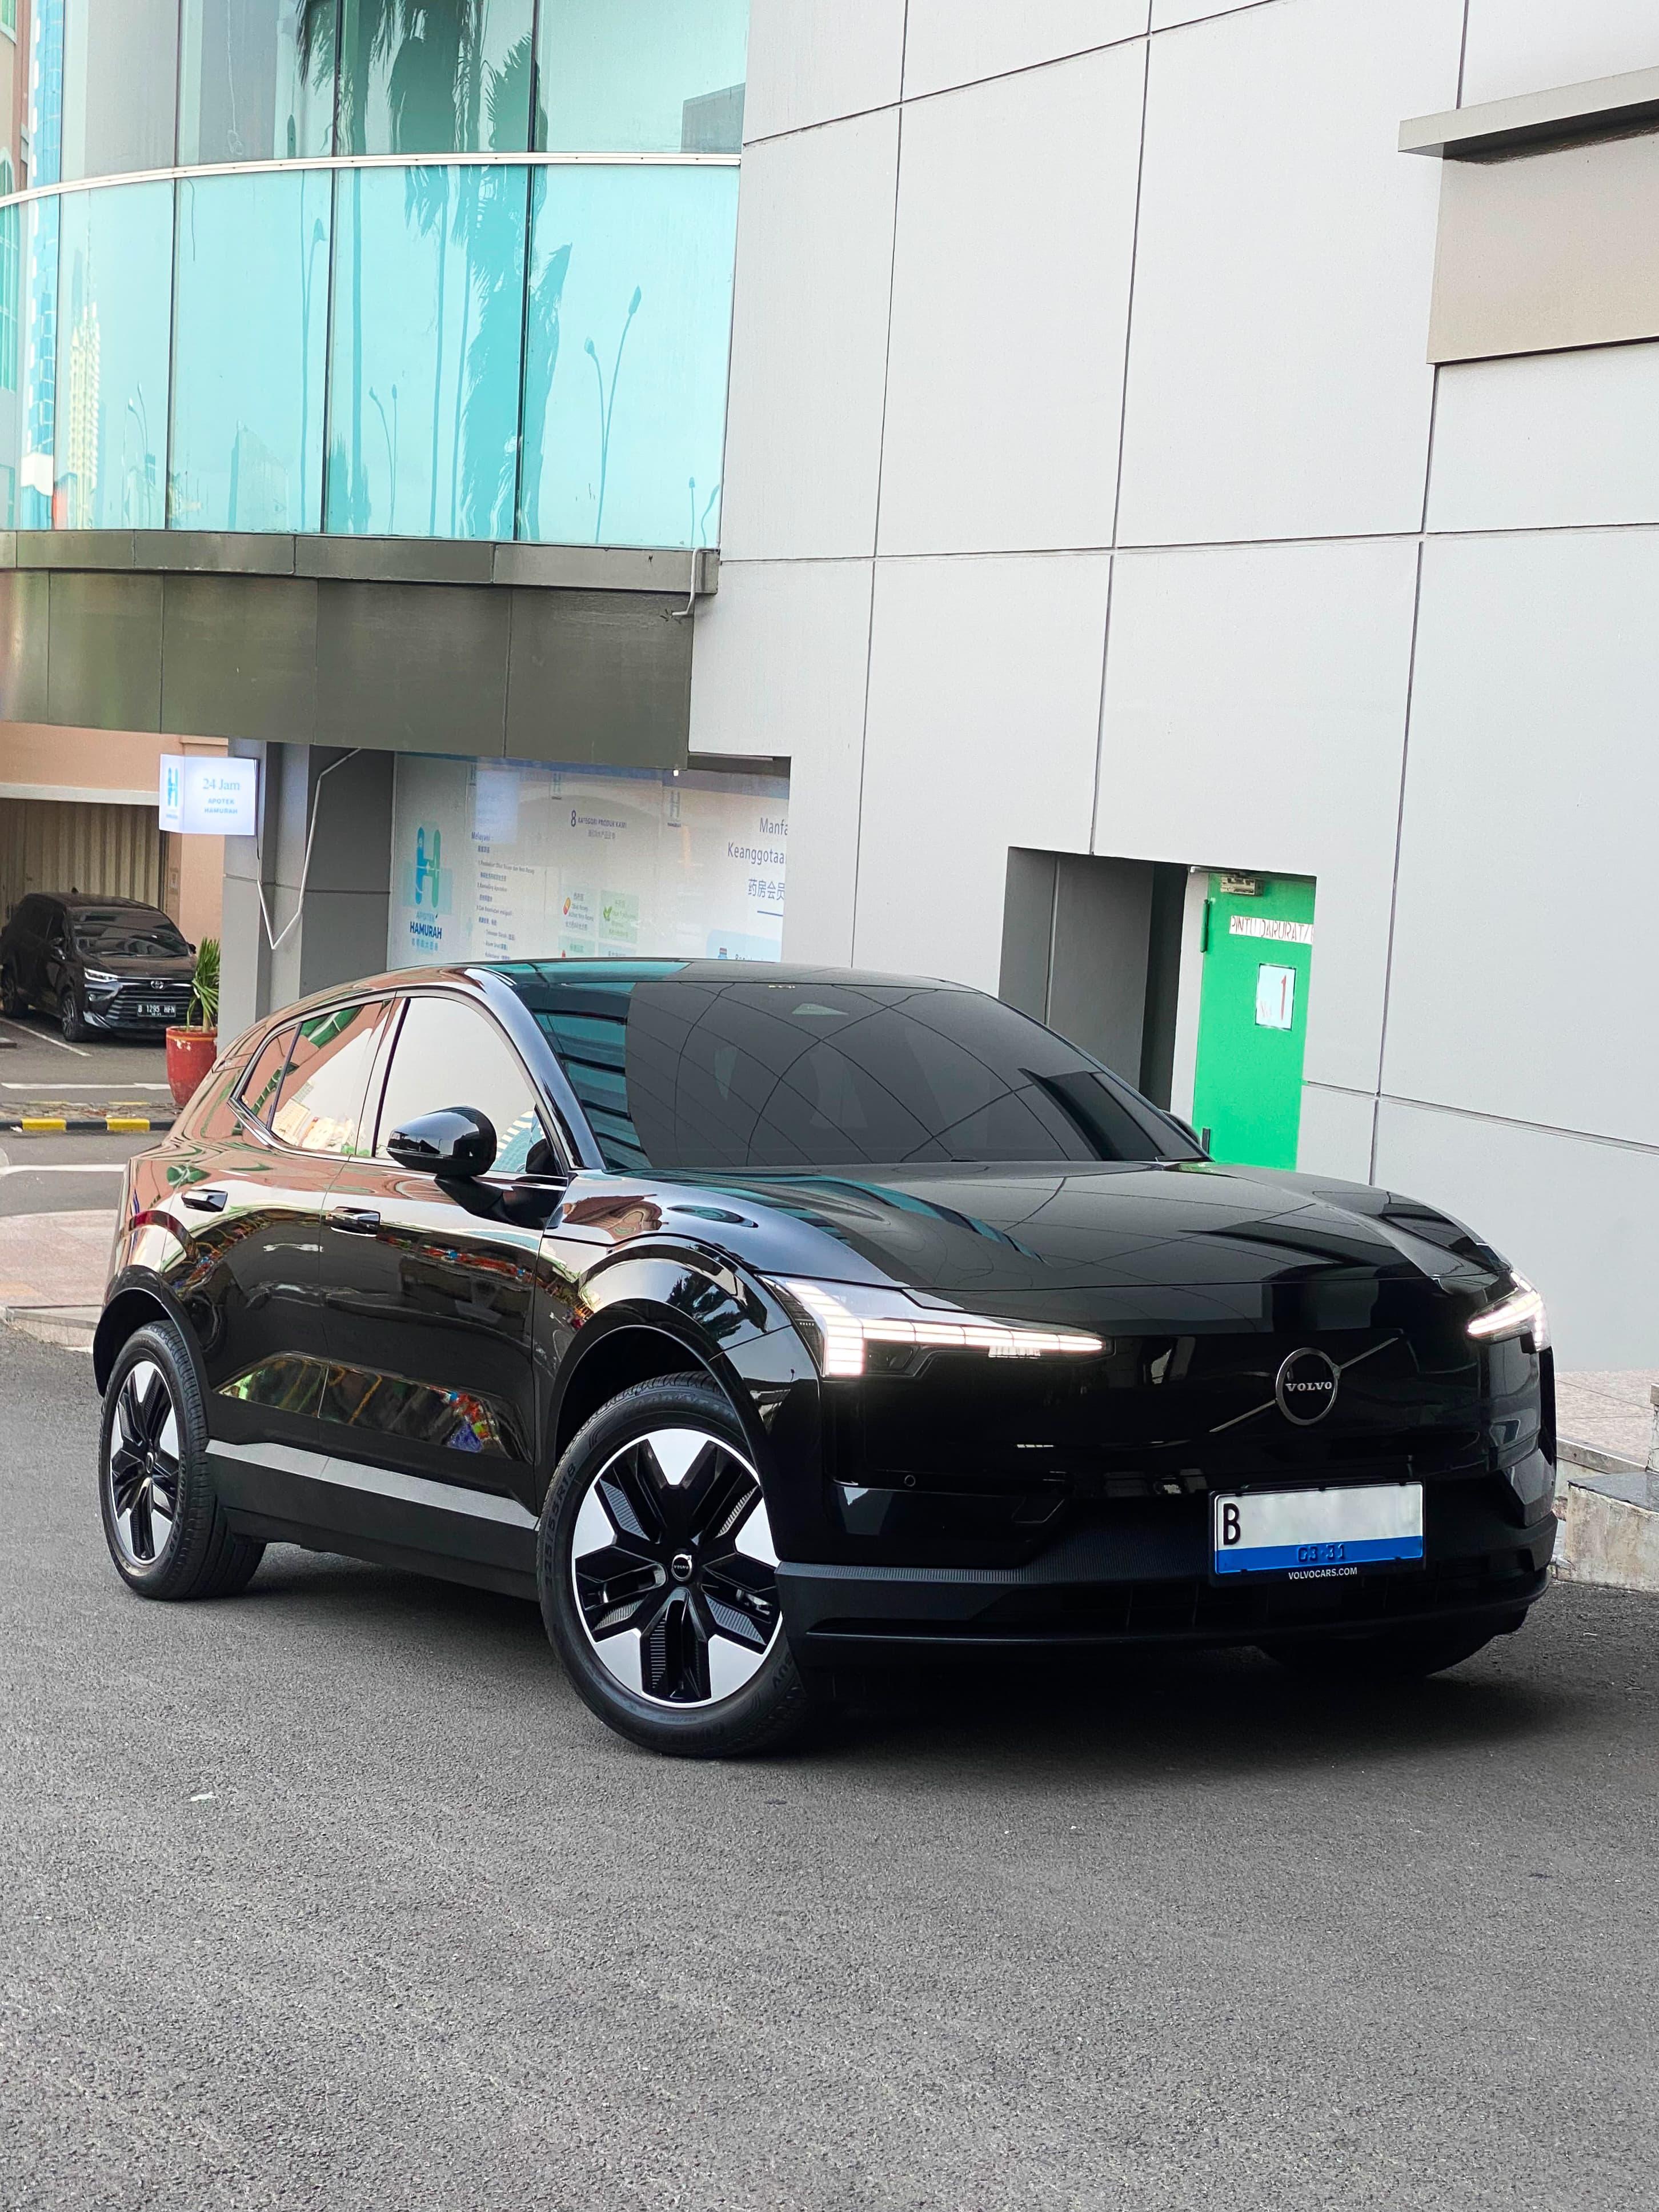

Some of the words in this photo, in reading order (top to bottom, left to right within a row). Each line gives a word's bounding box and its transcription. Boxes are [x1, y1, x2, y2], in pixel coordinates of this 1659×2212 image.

[203, 778, 215, 790] 24
[219, 779, 240, 791] Jam
[571, 810, 576, 827] 8
[728, 841, 787, 865] Keanggotaa
[410, 921, 442, 939] HAMURAH
[1285, 1381, 1332, 1392] VOLVO
[1223, 1502, 1241, 1546] B
[1288, 1566, 1357, 1580] VOLVOCARS.COM
